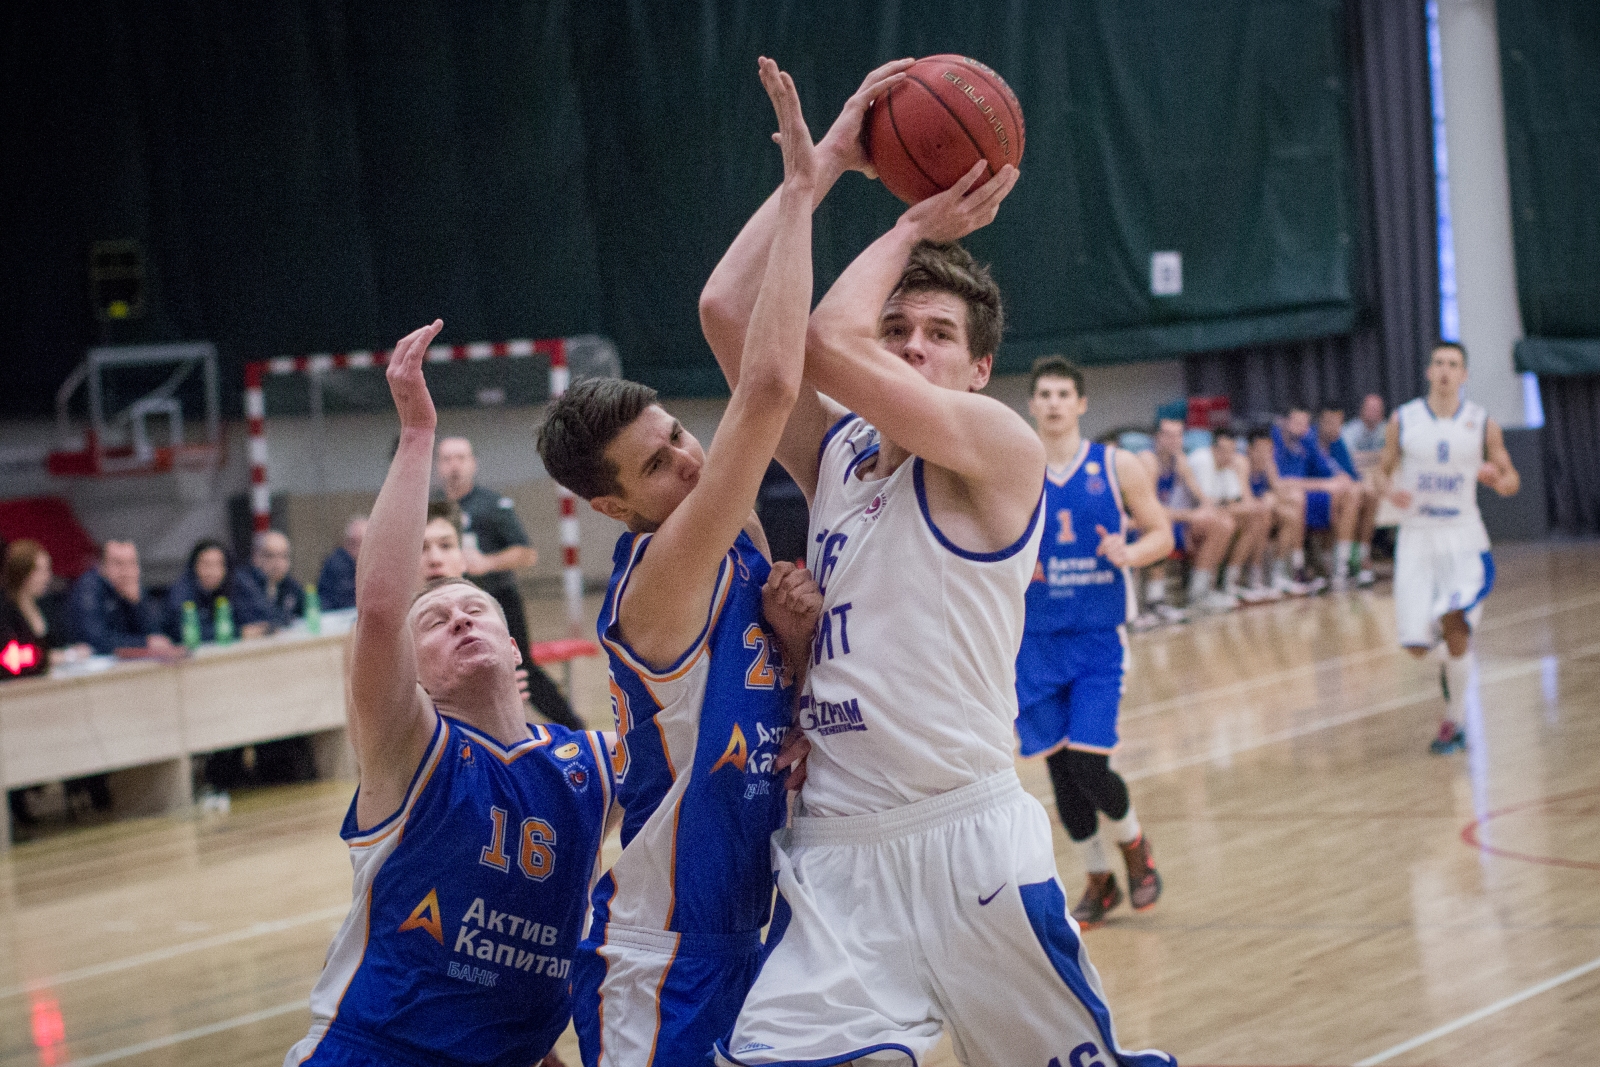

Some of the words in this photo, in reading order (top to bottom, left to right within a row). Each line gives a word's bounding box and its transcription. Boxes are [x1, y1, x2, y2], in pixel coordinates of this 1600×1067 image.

[942, 71, 1011, 157] SOLUTION
[1057, 510, 1076, 543] 1
[479, 804, 557, 882] 16
[462, 897, 558, 946] Актив
[447, 961, 500, 987] БАНК
[454, 925, 571, 979] Капитал
